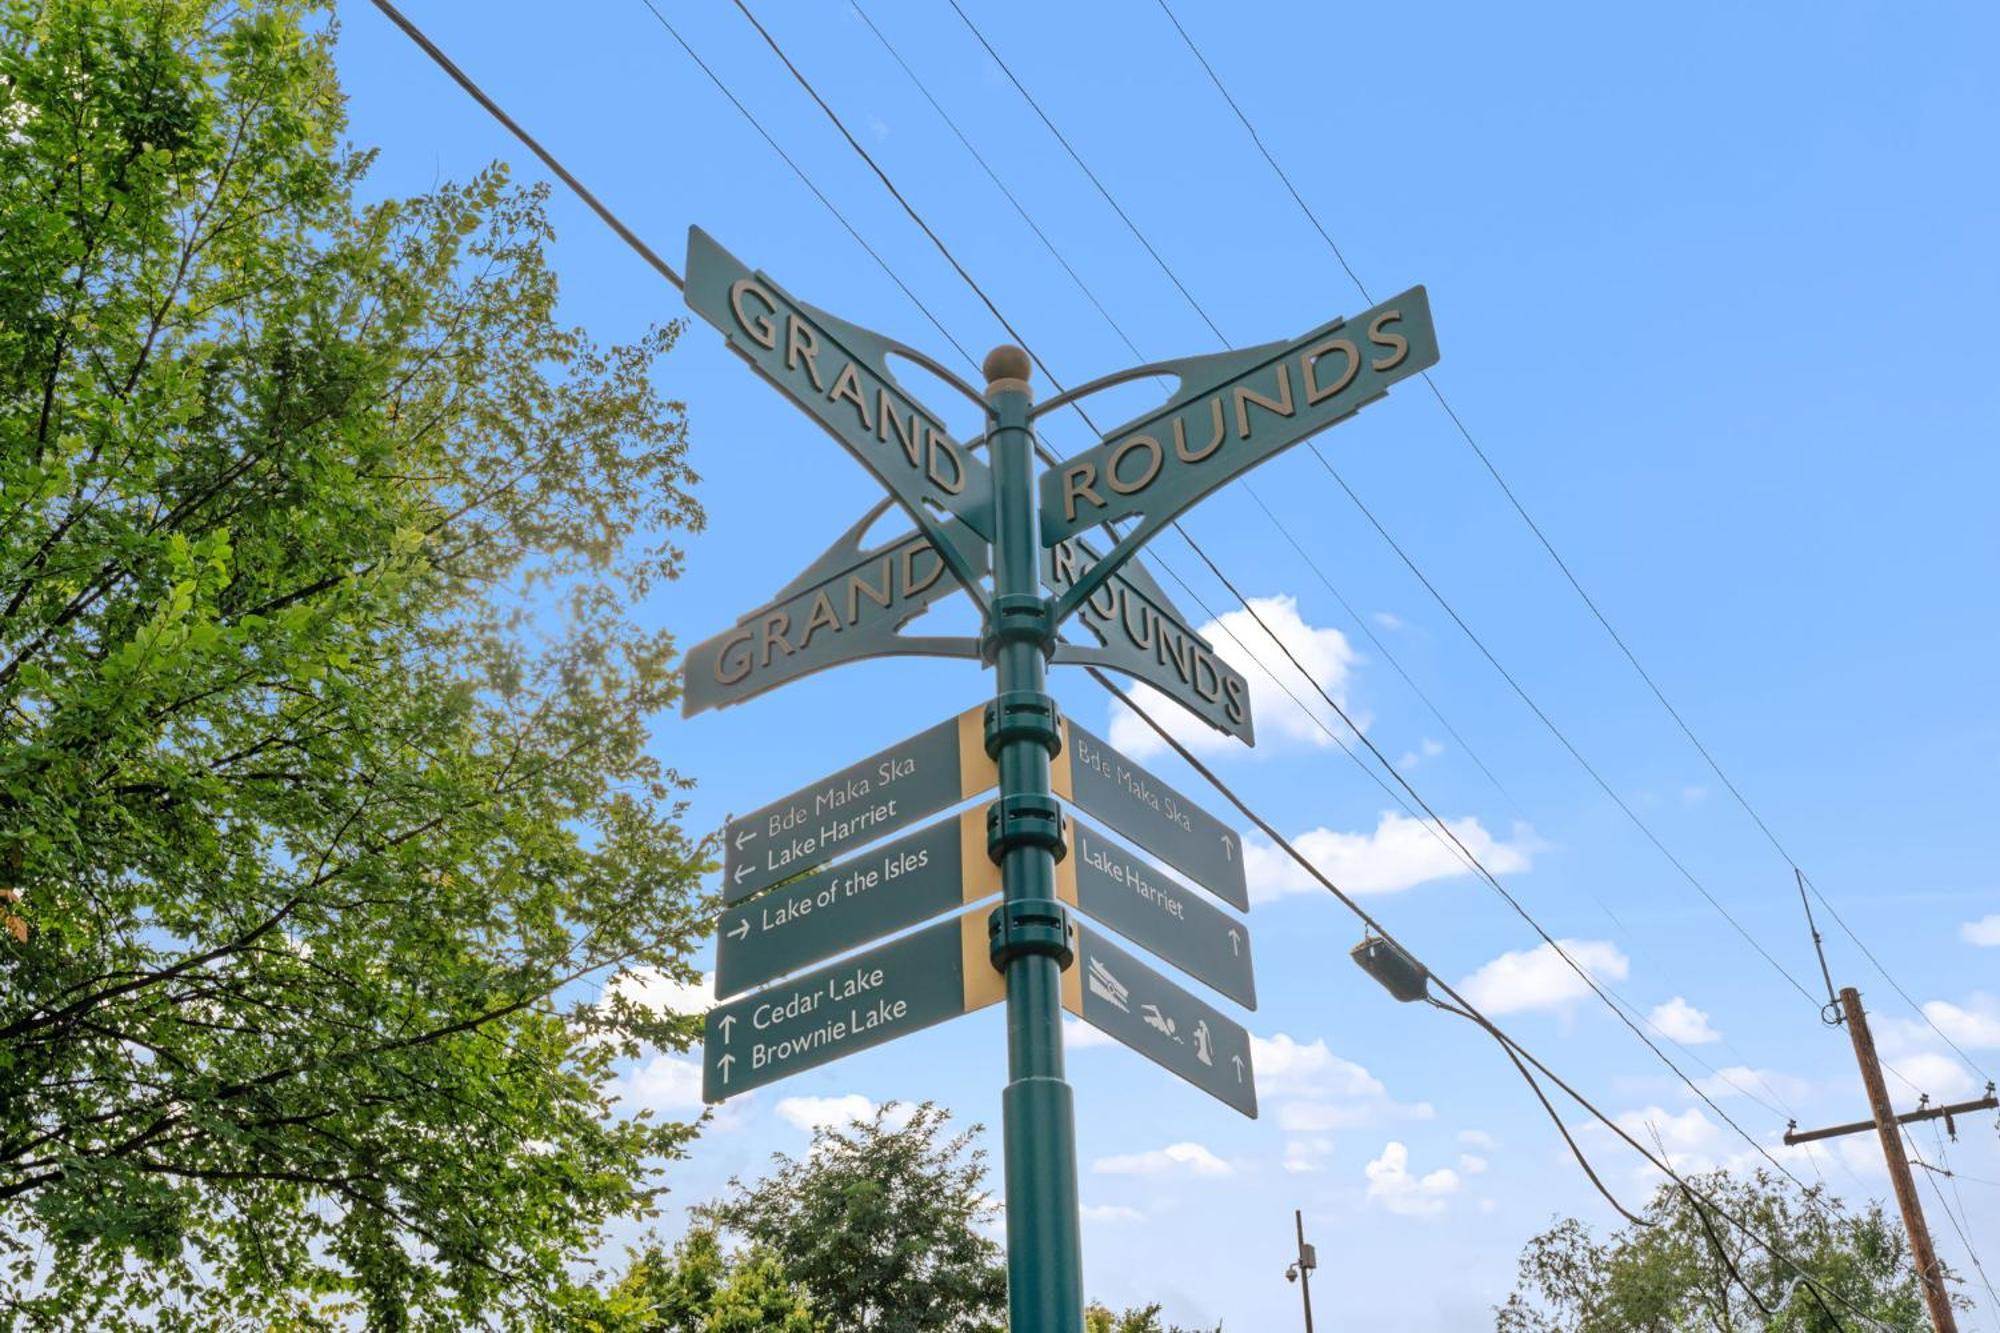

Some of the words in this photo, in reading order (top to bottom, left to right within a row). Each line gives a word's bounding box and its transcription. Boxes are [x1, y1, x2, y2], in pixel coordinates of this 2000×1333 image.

[729, 279, 965, 495] GRAND
[1062, 310, 1409, 521] ROUNDS
[713, 541, 945, 685] GRAND
[768, 807, 808, 838] Bde
[815, 779, 870, 816] Maka
[878, 757, 916, 787] Ska
[1078, 739, 1111, 778] Bde
[1117, 767, 1159, 811] Maka
[1165, 798, 1192, 833] Ska
[767, 838, 816, 871] Lake
[820, 800, 897, 848] Harriet
[762, 898, 812, 932] Lake
[817, 880, 838, 908] of
[845, 867, 879, 897] the
[884, 849, 929, 881] Isles
[1082, 839, 1123, 882] Lake
[1126, 866, 1185, 920] Harriet
[752, 990, 824, 1030] Cedar
[829, 968, 884, 1001] Lake
[752, 1020, 846, 1070] Brownie
[851, 1000, 908, 1034] Lake
